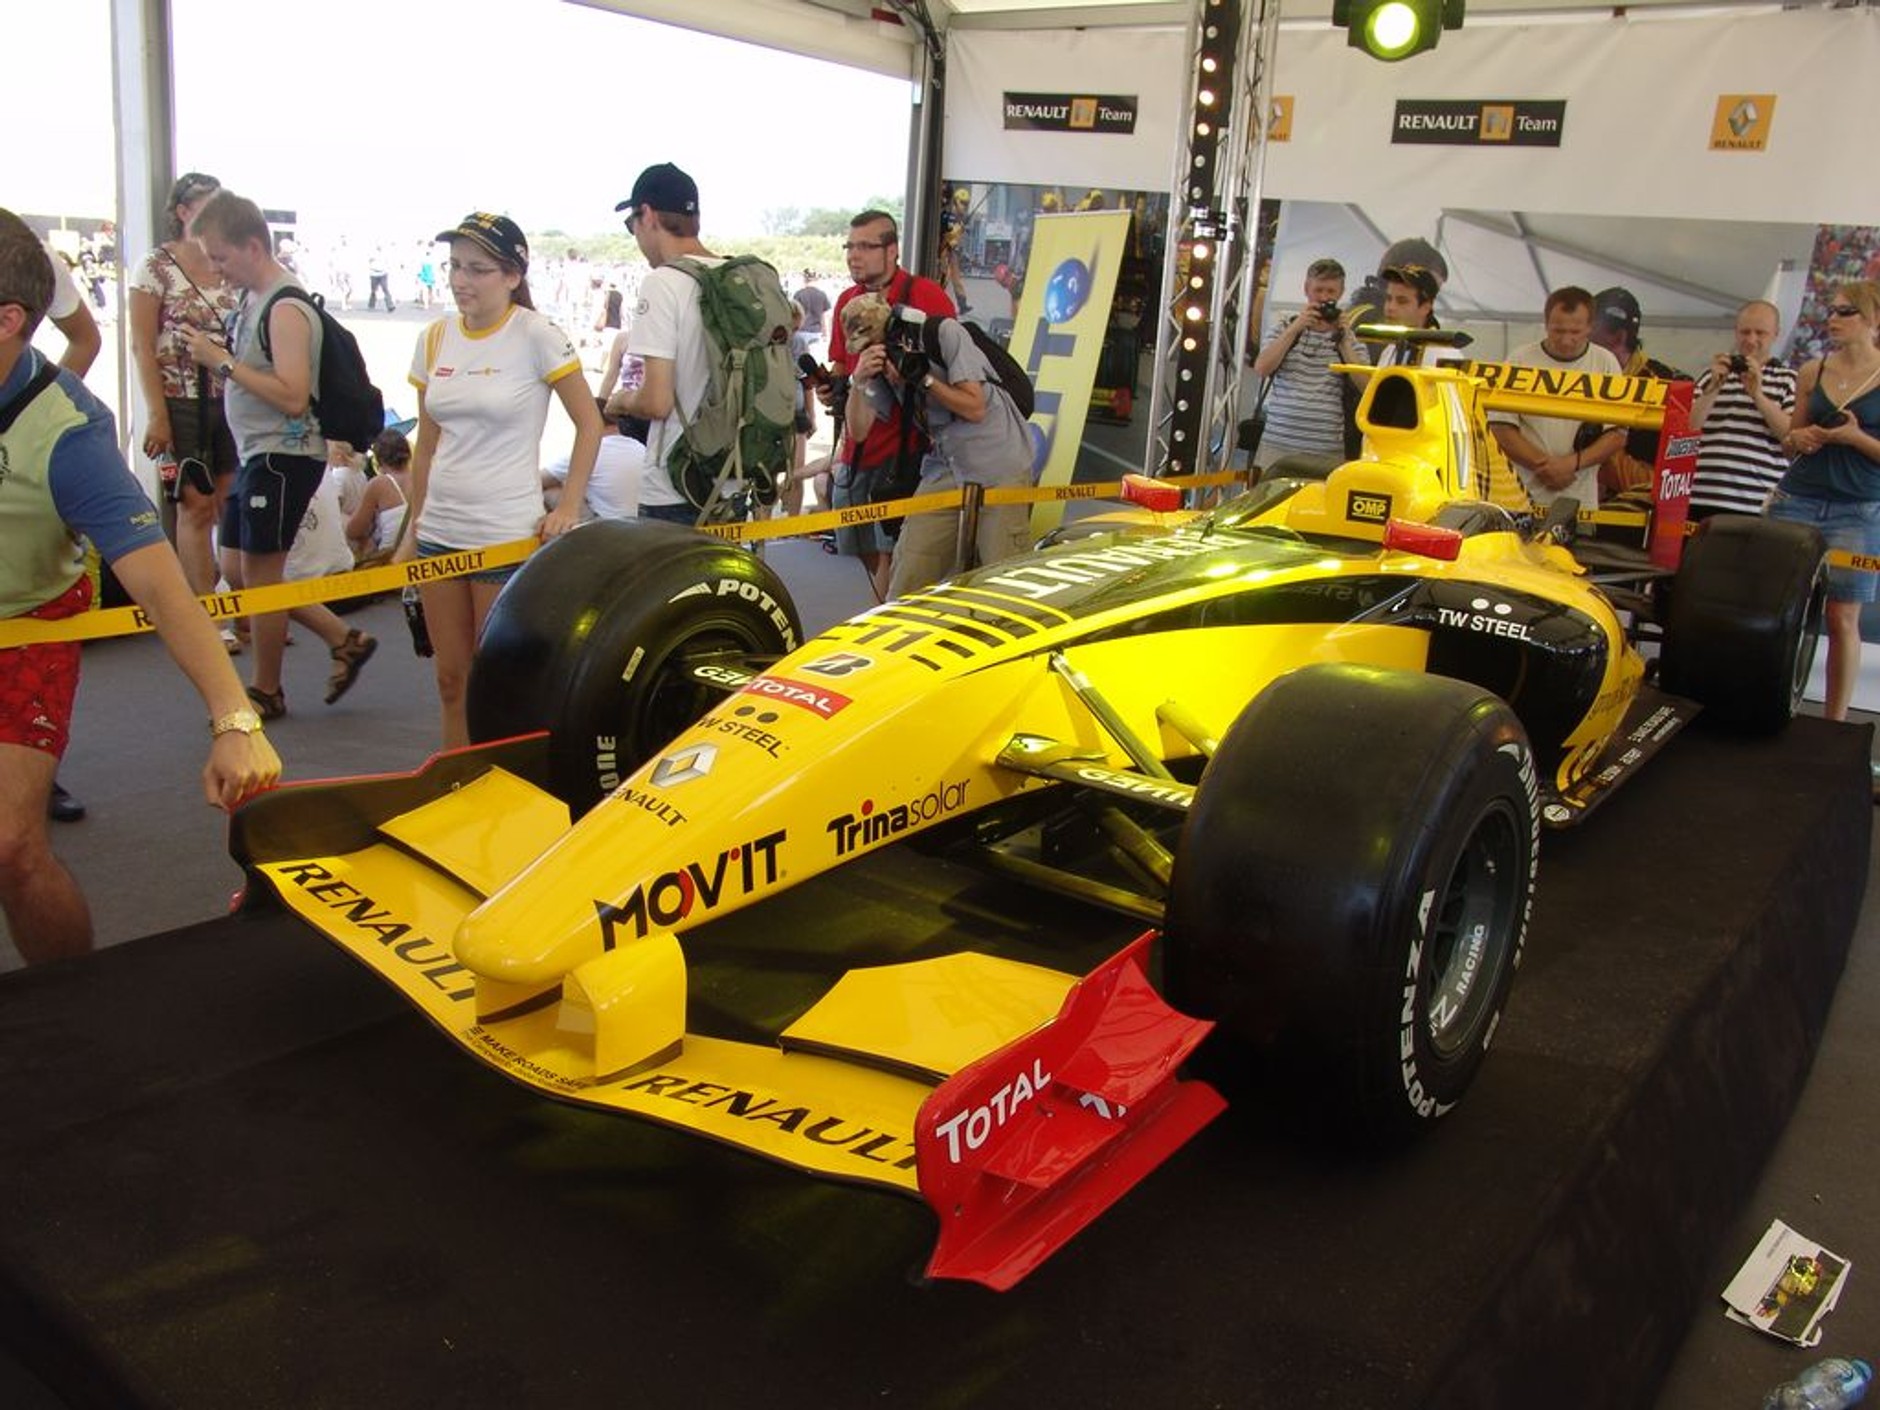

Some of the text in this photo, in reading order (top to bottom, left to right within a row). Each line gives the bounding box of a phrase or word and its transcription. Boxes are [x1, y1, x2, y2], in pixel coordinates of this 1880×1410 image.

[1006, 104, 1068, 120] RENAULT
[1099, 106, 1133, 122] Team
[1398, 114, 1479, 131] RENAULT
[1516, 115, 1557, 132] Team
[1713, 139, 1763, 150] RENAULT
[1055, 485, 1096, 500] RENAULT
[1660, 469, 1692, 501] TOTAL
[840, 504, 888, 524] RENAULT
[1352, 500, 1386, 516] OMP
[406, 551, 486, 583] RENAULT
[132, 594, 242, 629] RULT
[1438, 607, 1533, 642] TW STEEL
[752, 679, 832, 713] TOTAL
[719, 722, 780, 759] STEEL
[597, 734, 620, 800] ONE
[614, 786, 687, 828] NAULT
[1456, 925, 1485, 995] RACING
[1401, 889, 1436, 1118] POTENZA
[936, 1058, 1052, 1165] TOTAL
